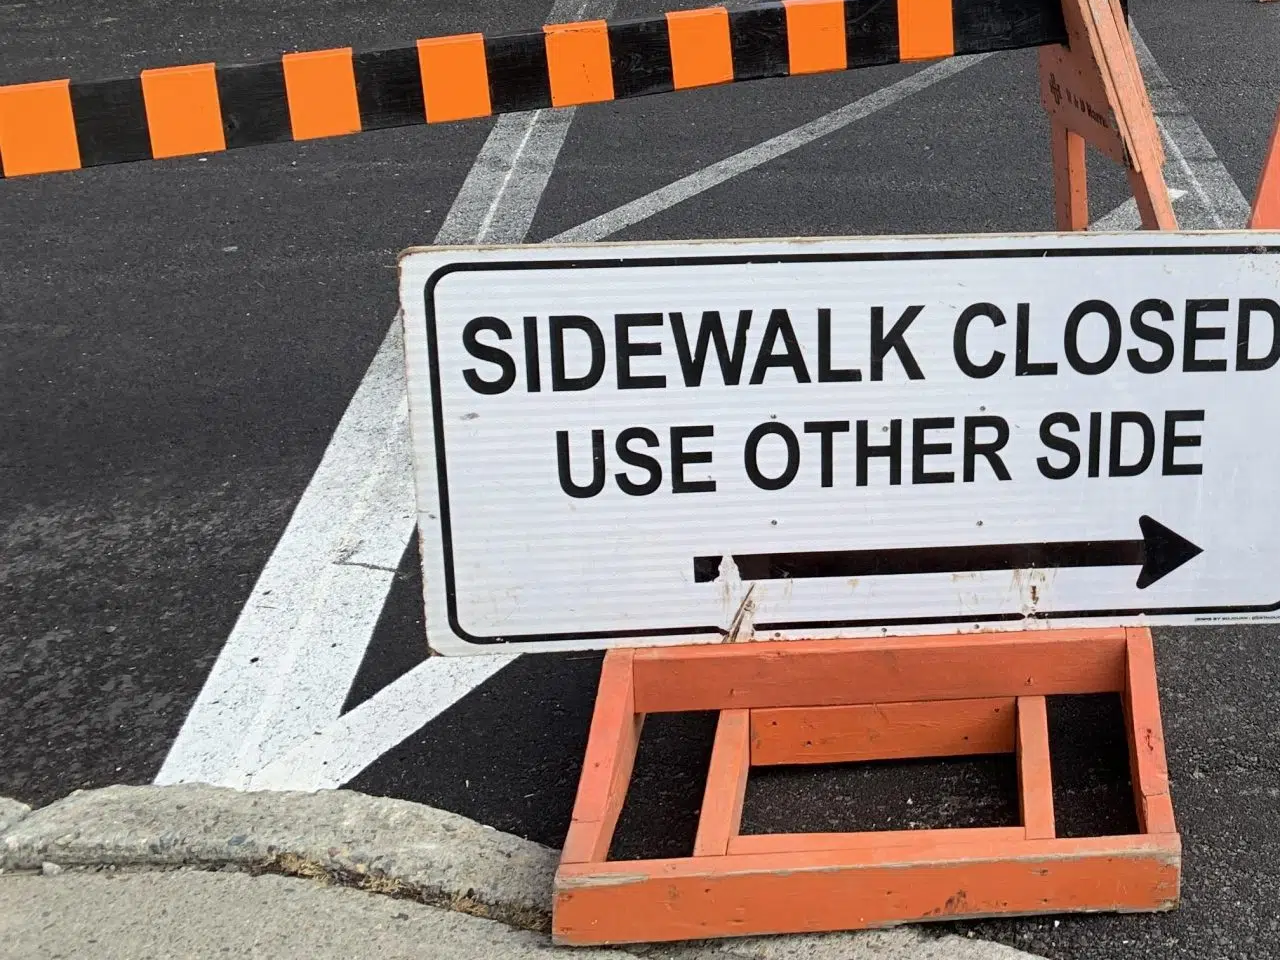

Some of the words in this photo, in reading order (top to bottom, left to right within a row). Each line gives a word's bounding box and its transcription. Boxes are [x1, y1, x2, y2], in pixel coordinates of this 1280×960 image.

[462, 305, 925, 395] SIDEWALK
[556, 425, 716, 498] USE
[743, 416, 1012, 491] OTHER
[1036, 409, 1205, 480] SIDE
